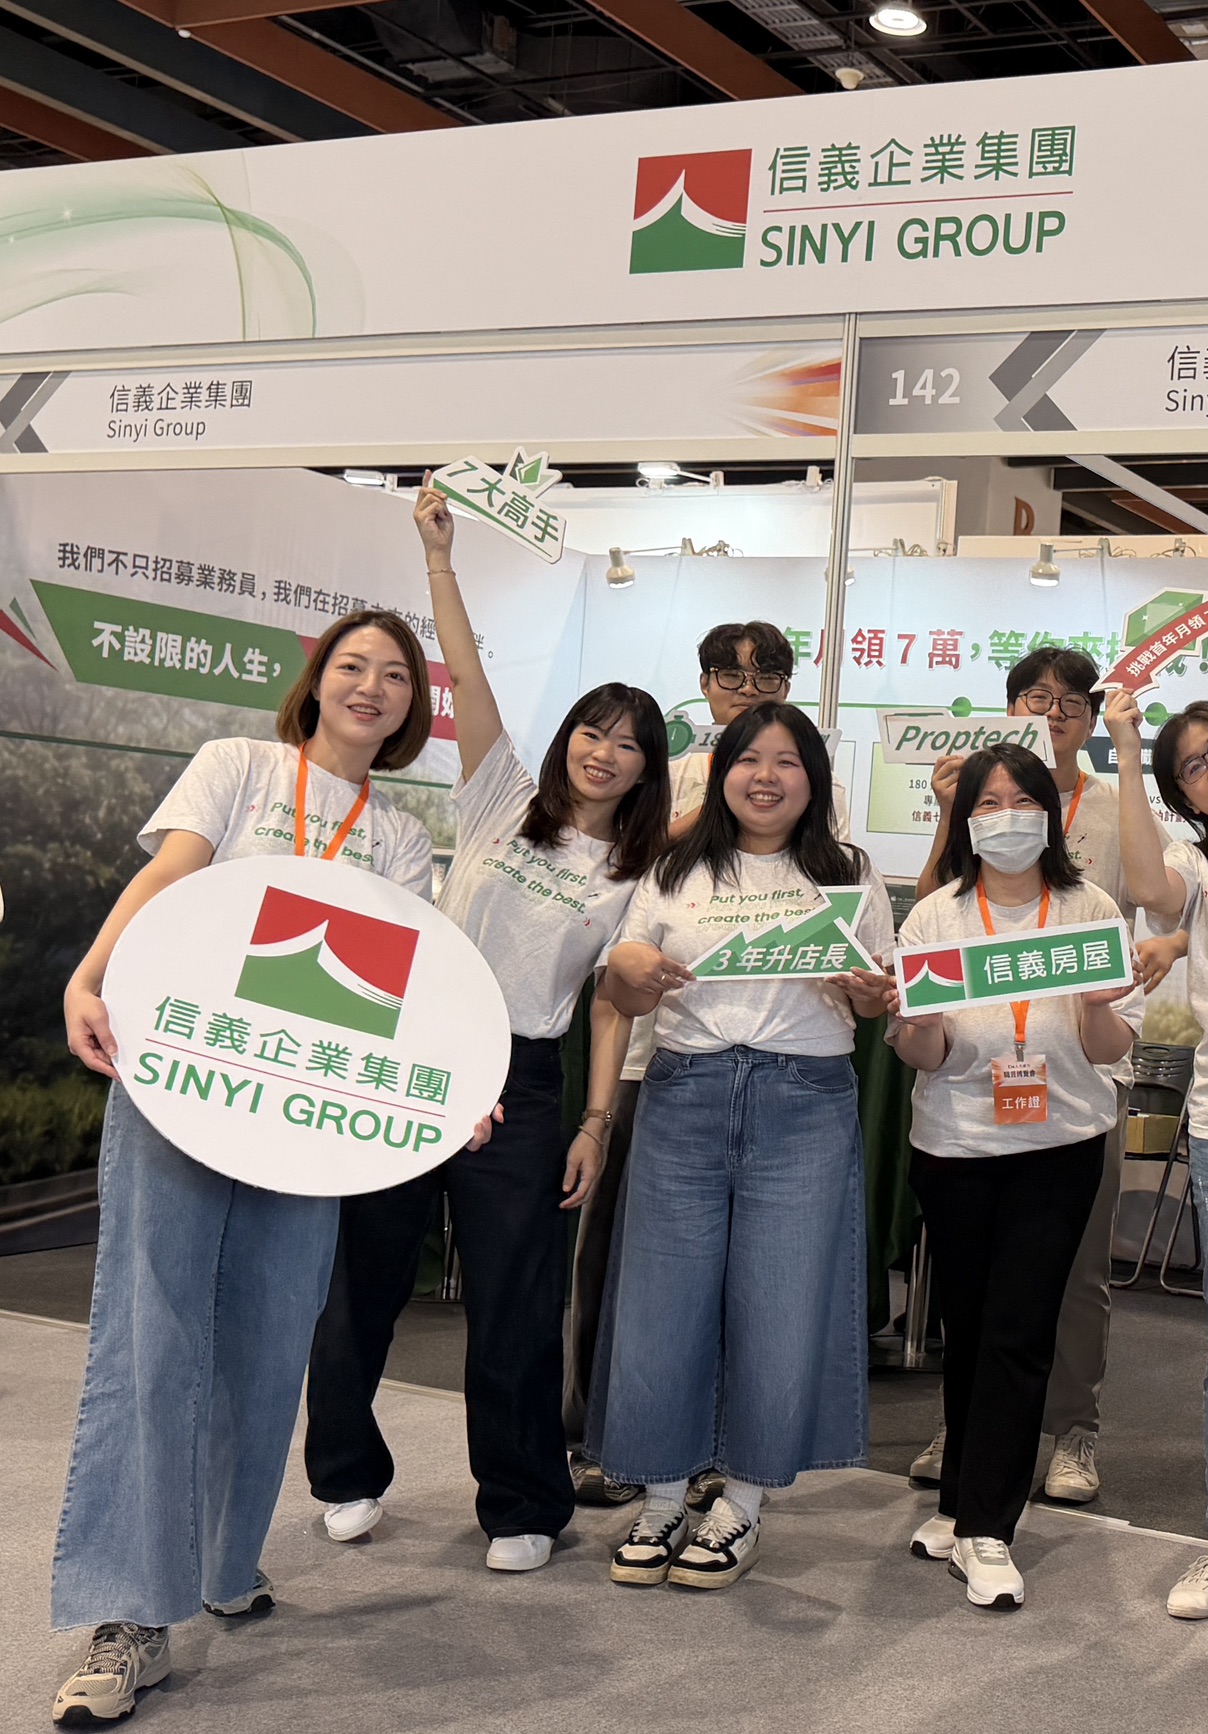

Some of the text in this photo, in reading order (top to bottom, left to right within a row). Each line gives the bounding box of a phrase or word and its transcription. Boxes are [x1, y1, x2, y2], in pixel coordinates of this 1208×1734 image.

[767, 125, 1077, 196] 信義企業集團
[759, 210, 1067, 268] SINYI GROUP
[109, 380, 253, 414] 信義企業集團
[887, 366, 962, 406] 142
[106, 417, 206, 443] Sinyi Group
[446, 460, 559, 543] 7大高手
[895, 722, 1039, 756] Proptech
[908, 779, 928, 789] 180
[506, 839, 531, 858] Put
[526, 855, 557, 873] you
[482, 857, 527, 884] create
[526, 880, 553, 898] the
[709, 887, 805, 905] Put you first,
[697, 907, 817, 925] create the bes
[983, 940, 1112, 985] 信義房屋
[153, 995, 452, 1106] 信義企業集團
[133, 1052, 444, 1153] SINYI GROUP
